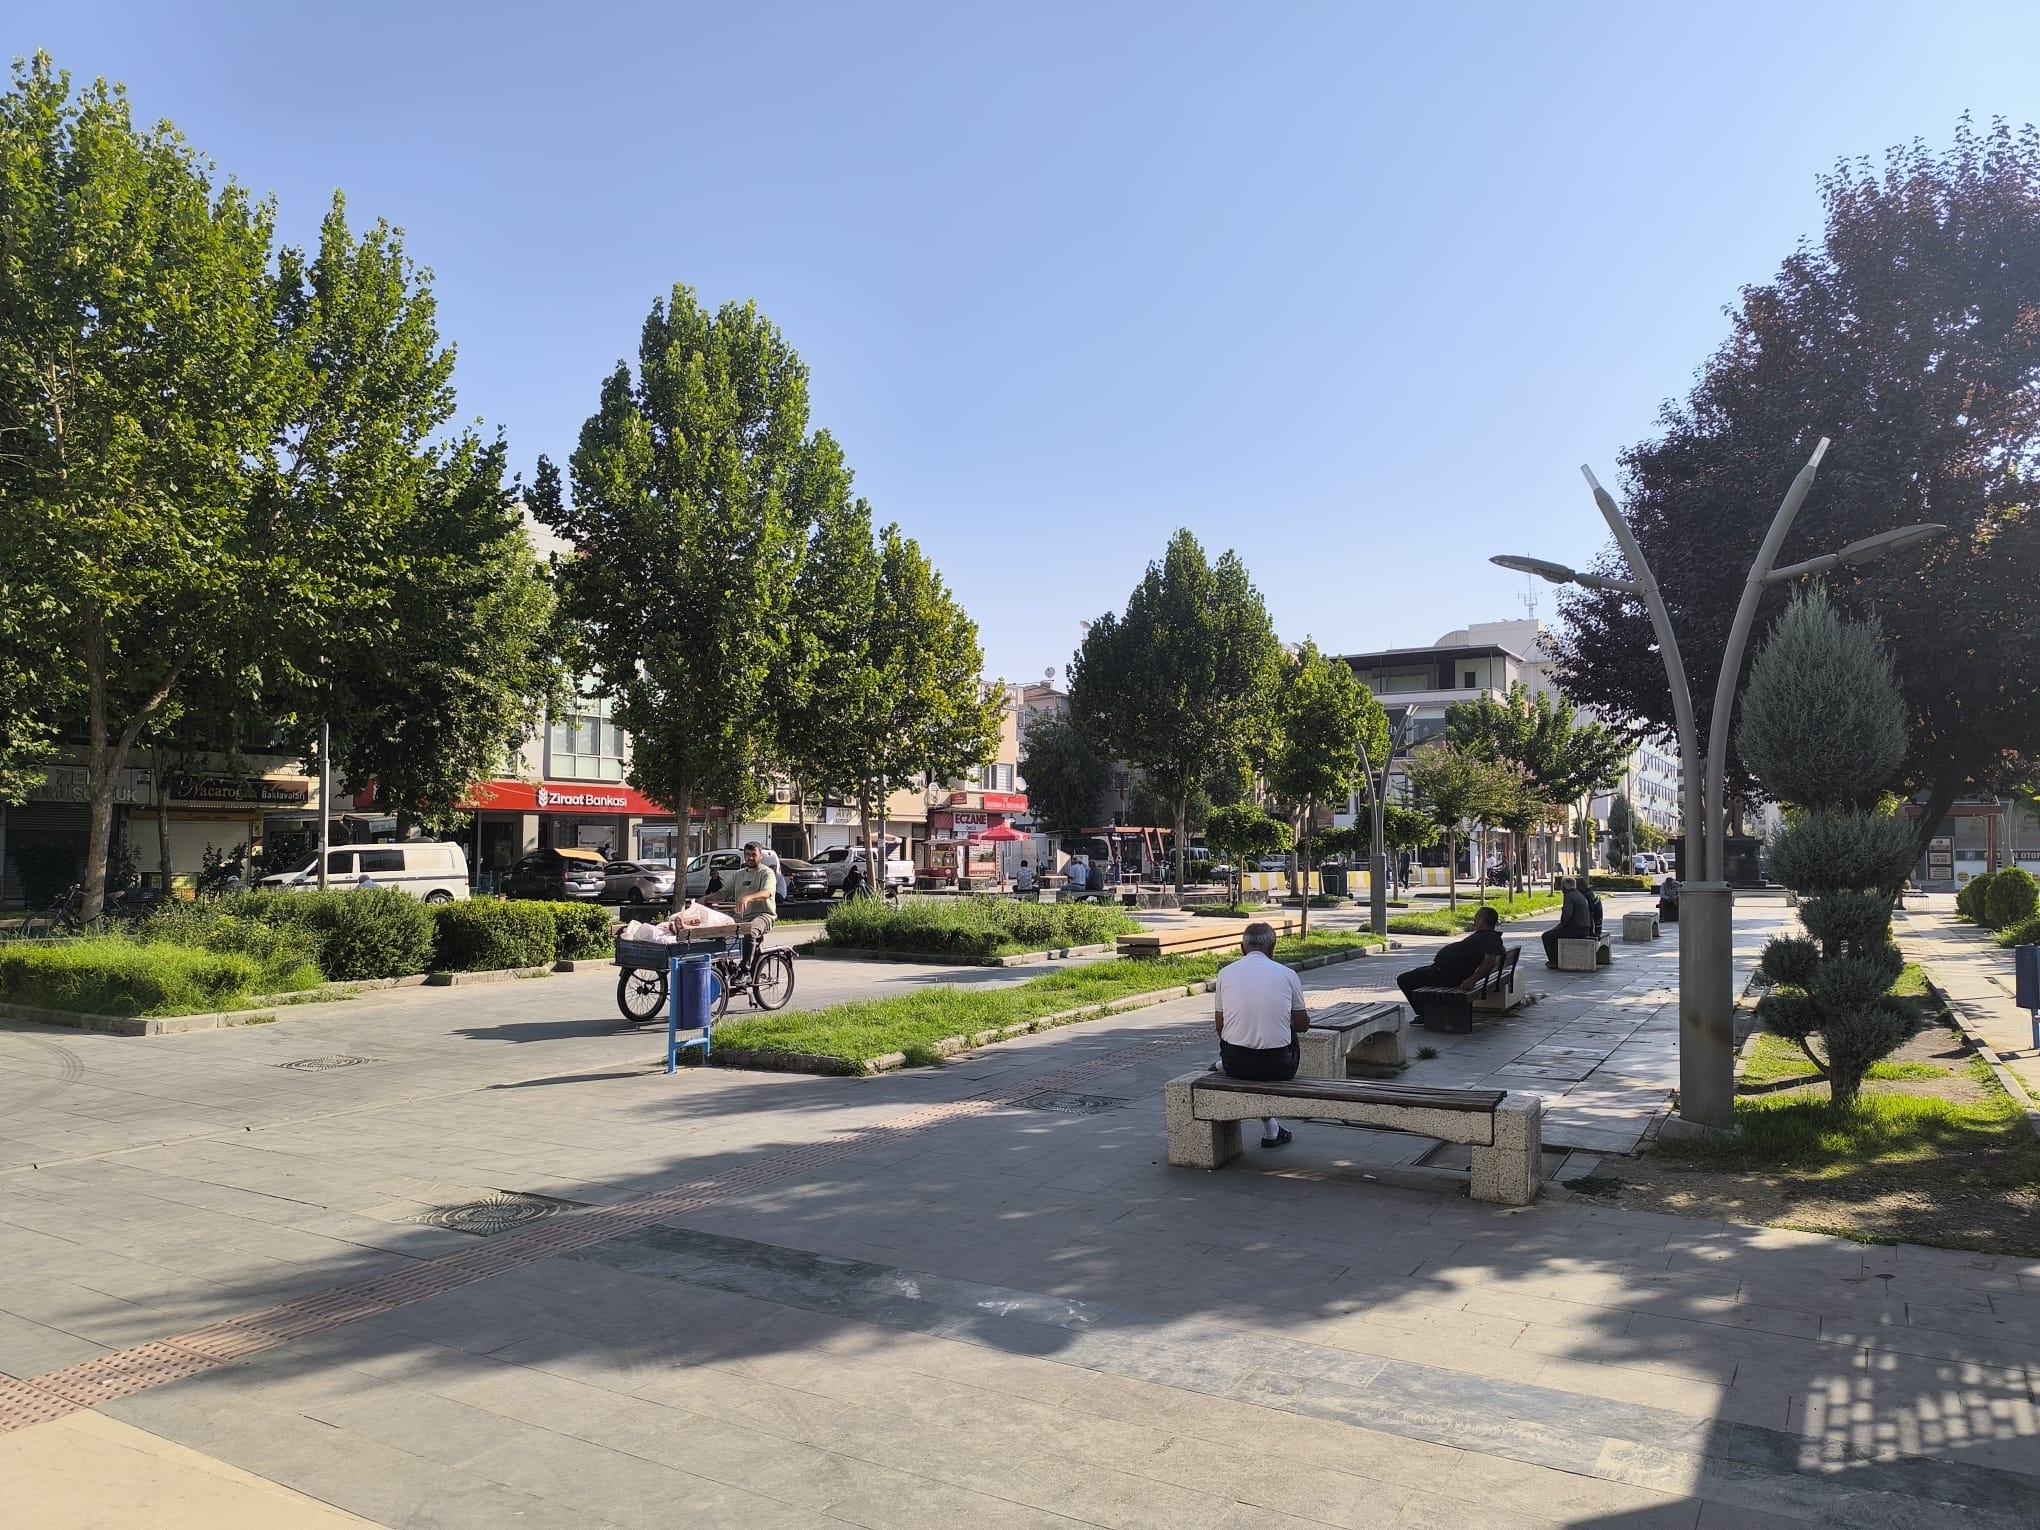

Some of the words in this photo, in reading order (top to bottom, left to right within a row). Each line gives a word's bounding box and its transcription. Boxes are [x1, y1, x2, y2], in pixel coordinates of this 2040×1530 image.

[548, 792, 585, 805] Ziraat
[585, 794, 627, 807] Bankası
[955, 813, 986, 825] ECZANE
